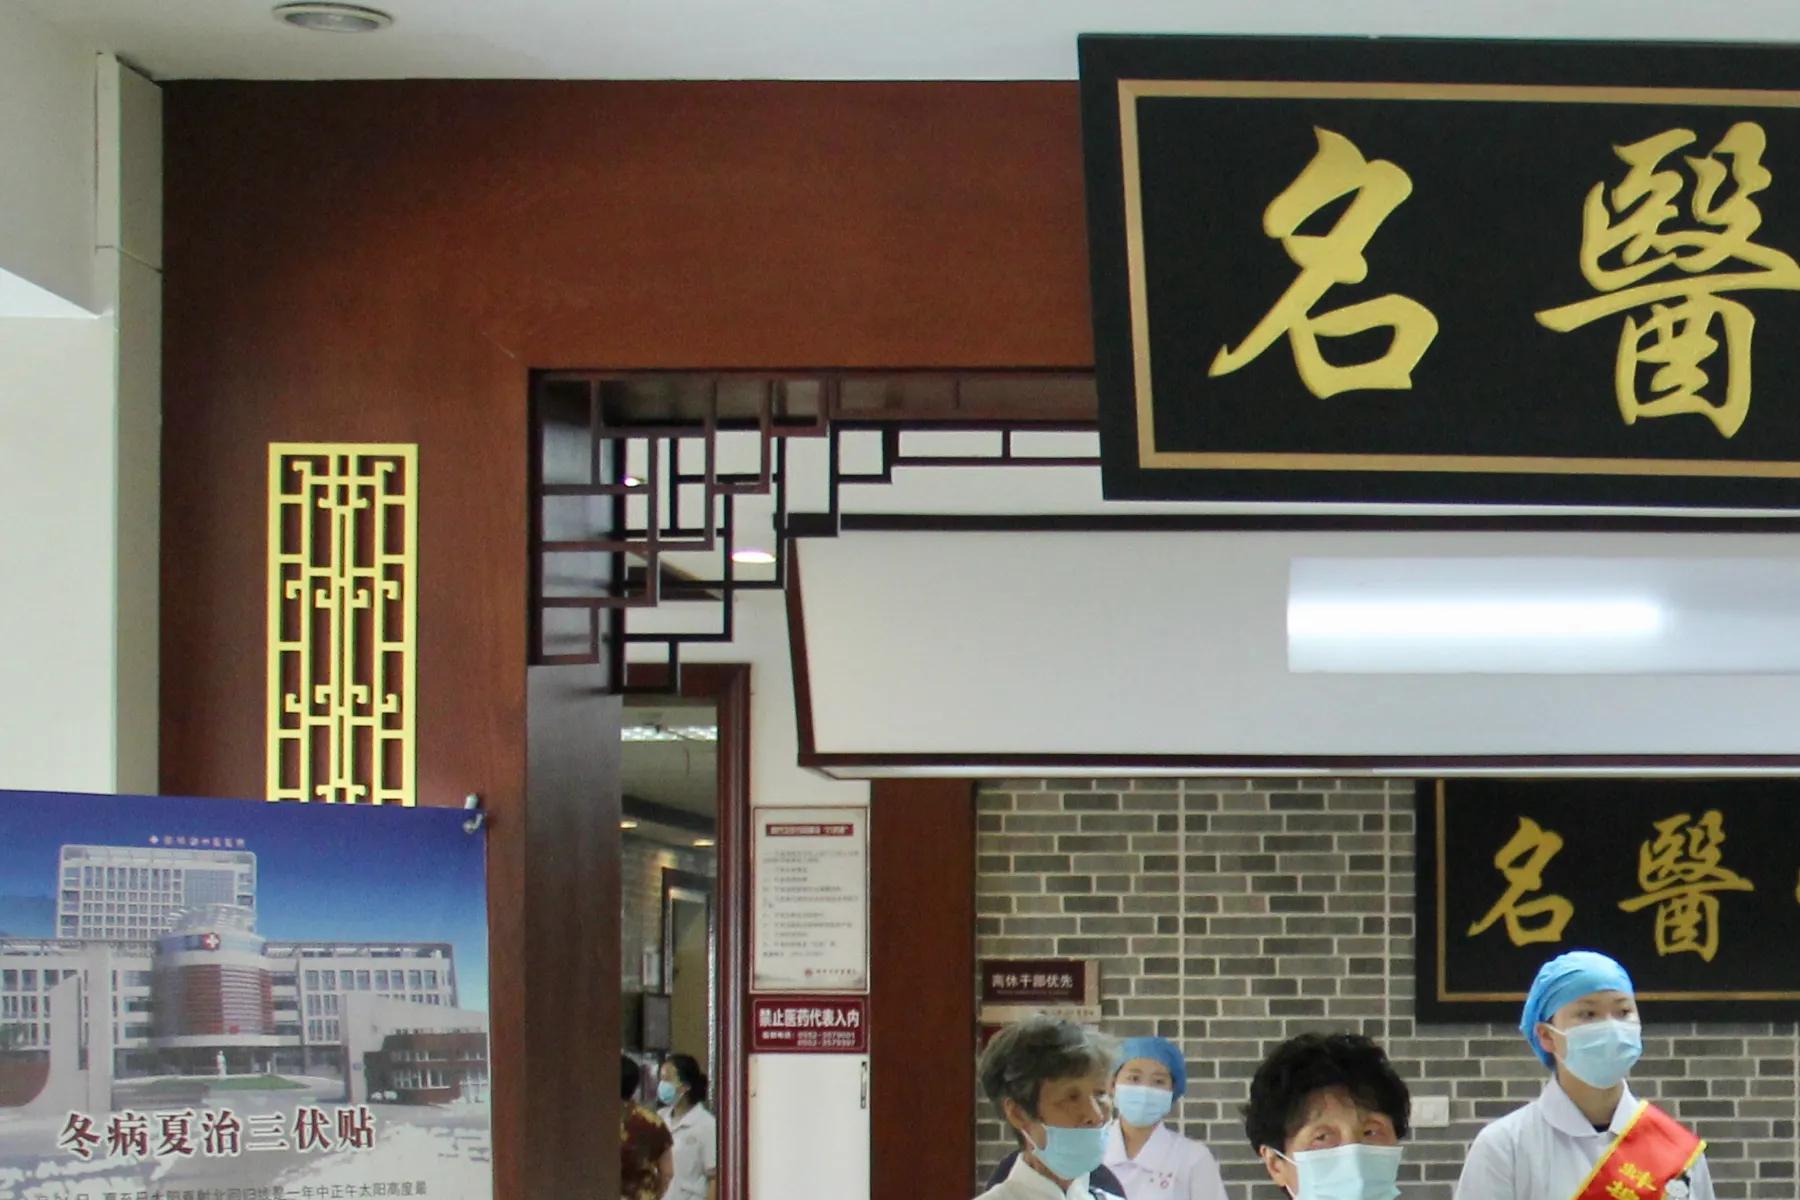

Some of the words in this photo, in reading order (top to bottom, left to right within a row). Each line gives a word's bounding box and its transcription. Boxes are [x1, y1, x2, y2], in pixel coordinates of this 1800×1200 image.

[60, 1106, 377, 1158] 冬病夏治三伏贴
